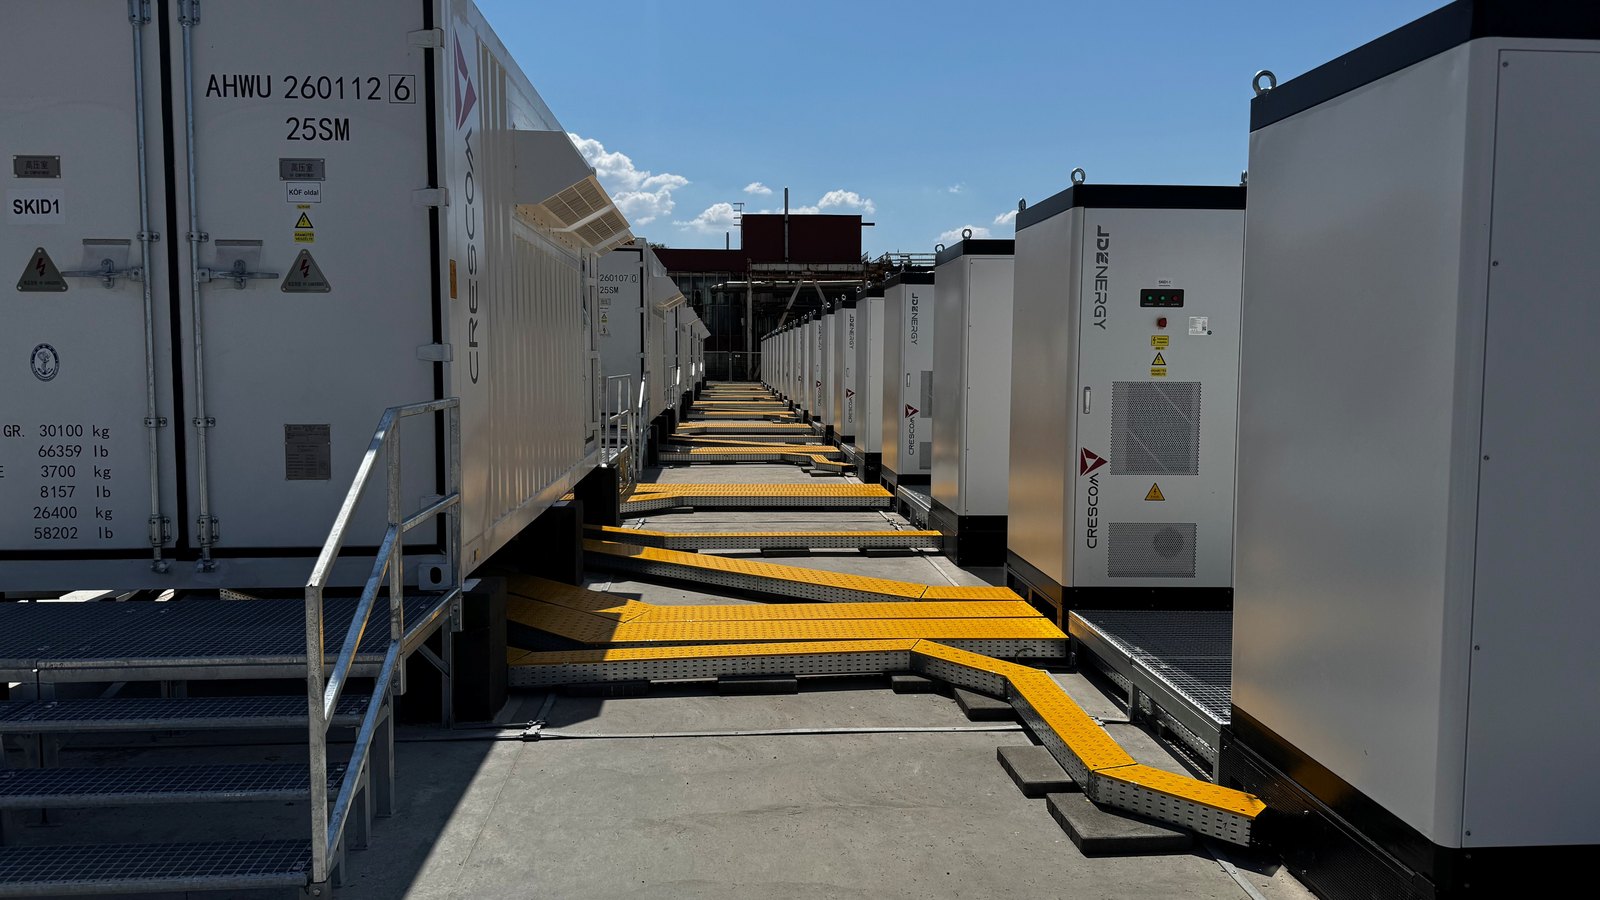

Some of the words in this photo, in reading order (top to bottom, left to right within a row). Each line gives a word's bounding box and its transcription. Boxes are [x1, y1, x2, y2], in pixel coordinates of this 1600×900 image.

[206, 74, 271, 98] AHWU
[284, 75, 381, 101] 260112
[395, 77, 410, 101] 6
[286, 117, 350, 141] 25SM
[13, 199, 60, 215] SKID1
[465, 127, 479, 385] CRESCOM
[600, 274, 629, 282] 260107
[1093, 225, 1110, 331] JDENERGY
[600, 286, 619, 294] 25SM
[3, 425, 25, 437] GR.
[39, 424, 83, 437] 30100
[92, 424, 110, 440] kg
[908, 416, 916, 456] CRESCOM
[38, 445, 82, 458] 66359
[93, 445, 109, 457] lb
[41, 465, 76, 478] 3700
[93, 465, 111, 480] kg
[40, 485, 76, 498] 8157
[96, 485, 111, 498] lb
[33, 506, 77, 519] 26400
[95, 506, 113, 521] kg
[1086, 472, 1099, 549] CRESCOM
[34, 526, 78, 539] 58202
[98, 526, 113, 539] lb
